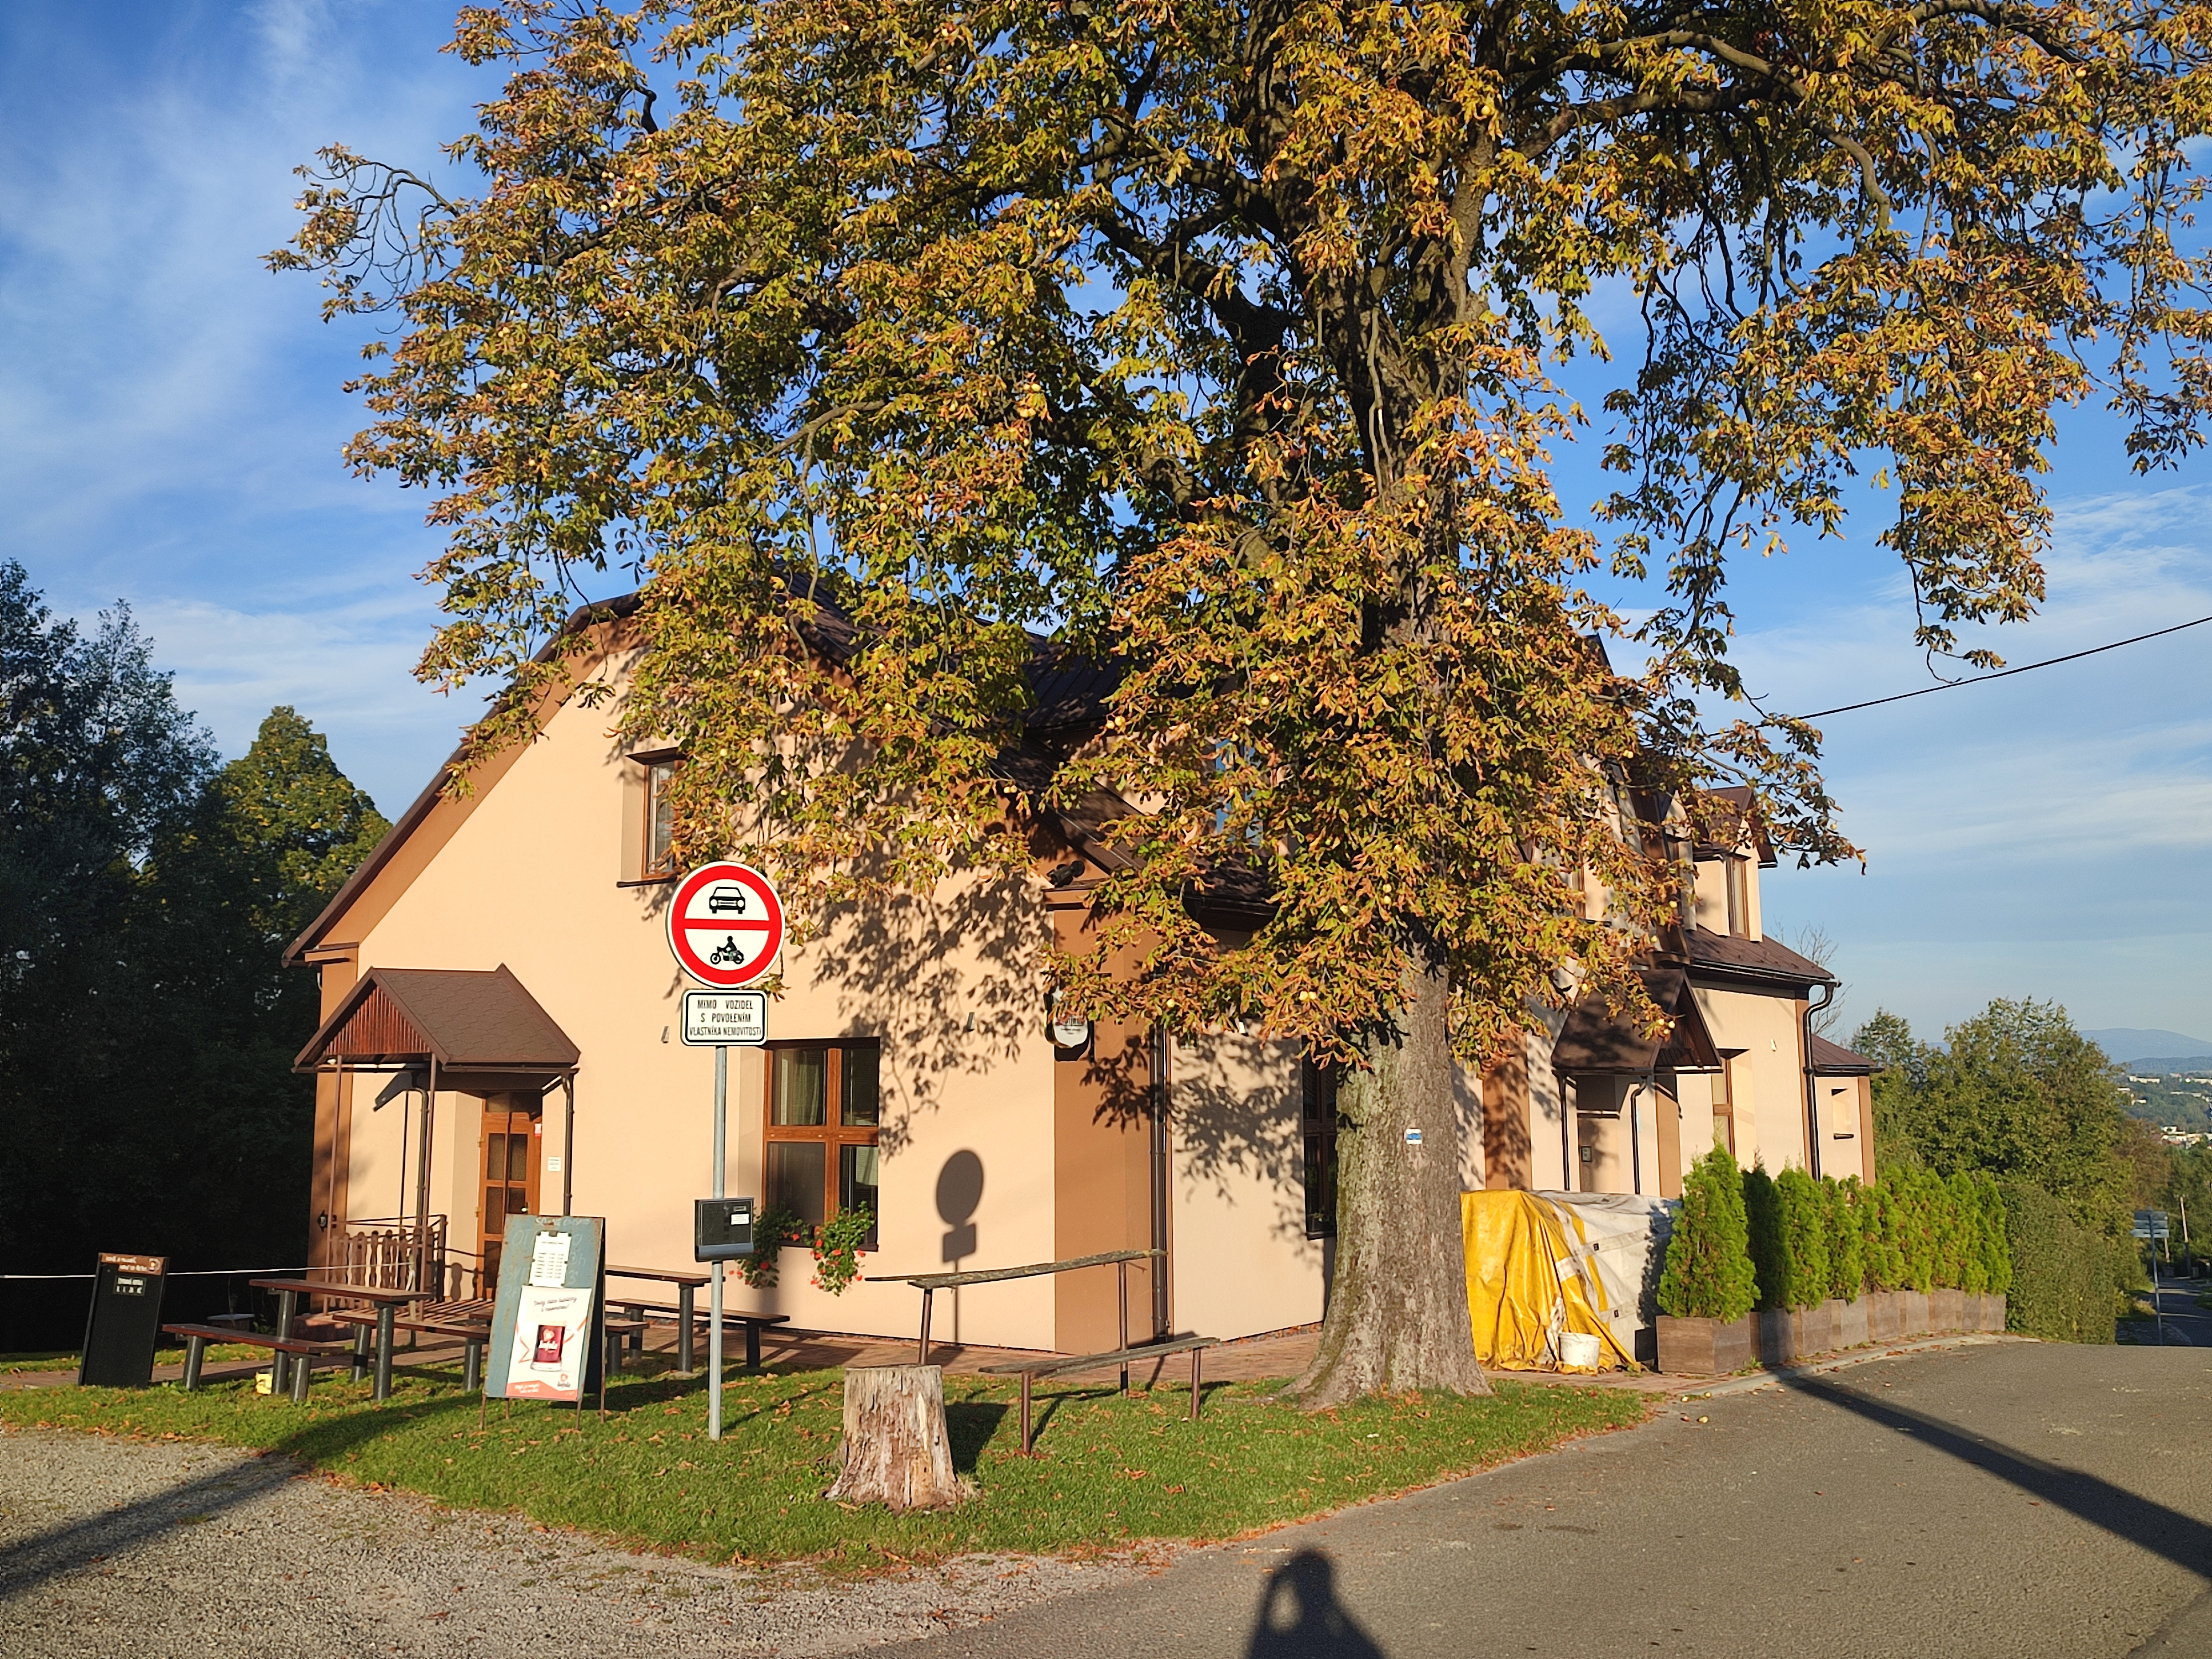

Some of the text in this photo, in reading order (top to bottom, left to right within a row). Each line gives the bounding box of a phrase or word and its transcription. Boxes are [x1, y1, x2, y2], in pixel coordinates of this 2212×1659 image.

[697, 999, 753, 1010] MIMO VOZIDEL
[700, 1011, 751, 1022] S POVOLENÍM
[690, 1025, 761, 1036] VLASTNÍKA NEMOVITOSTI
